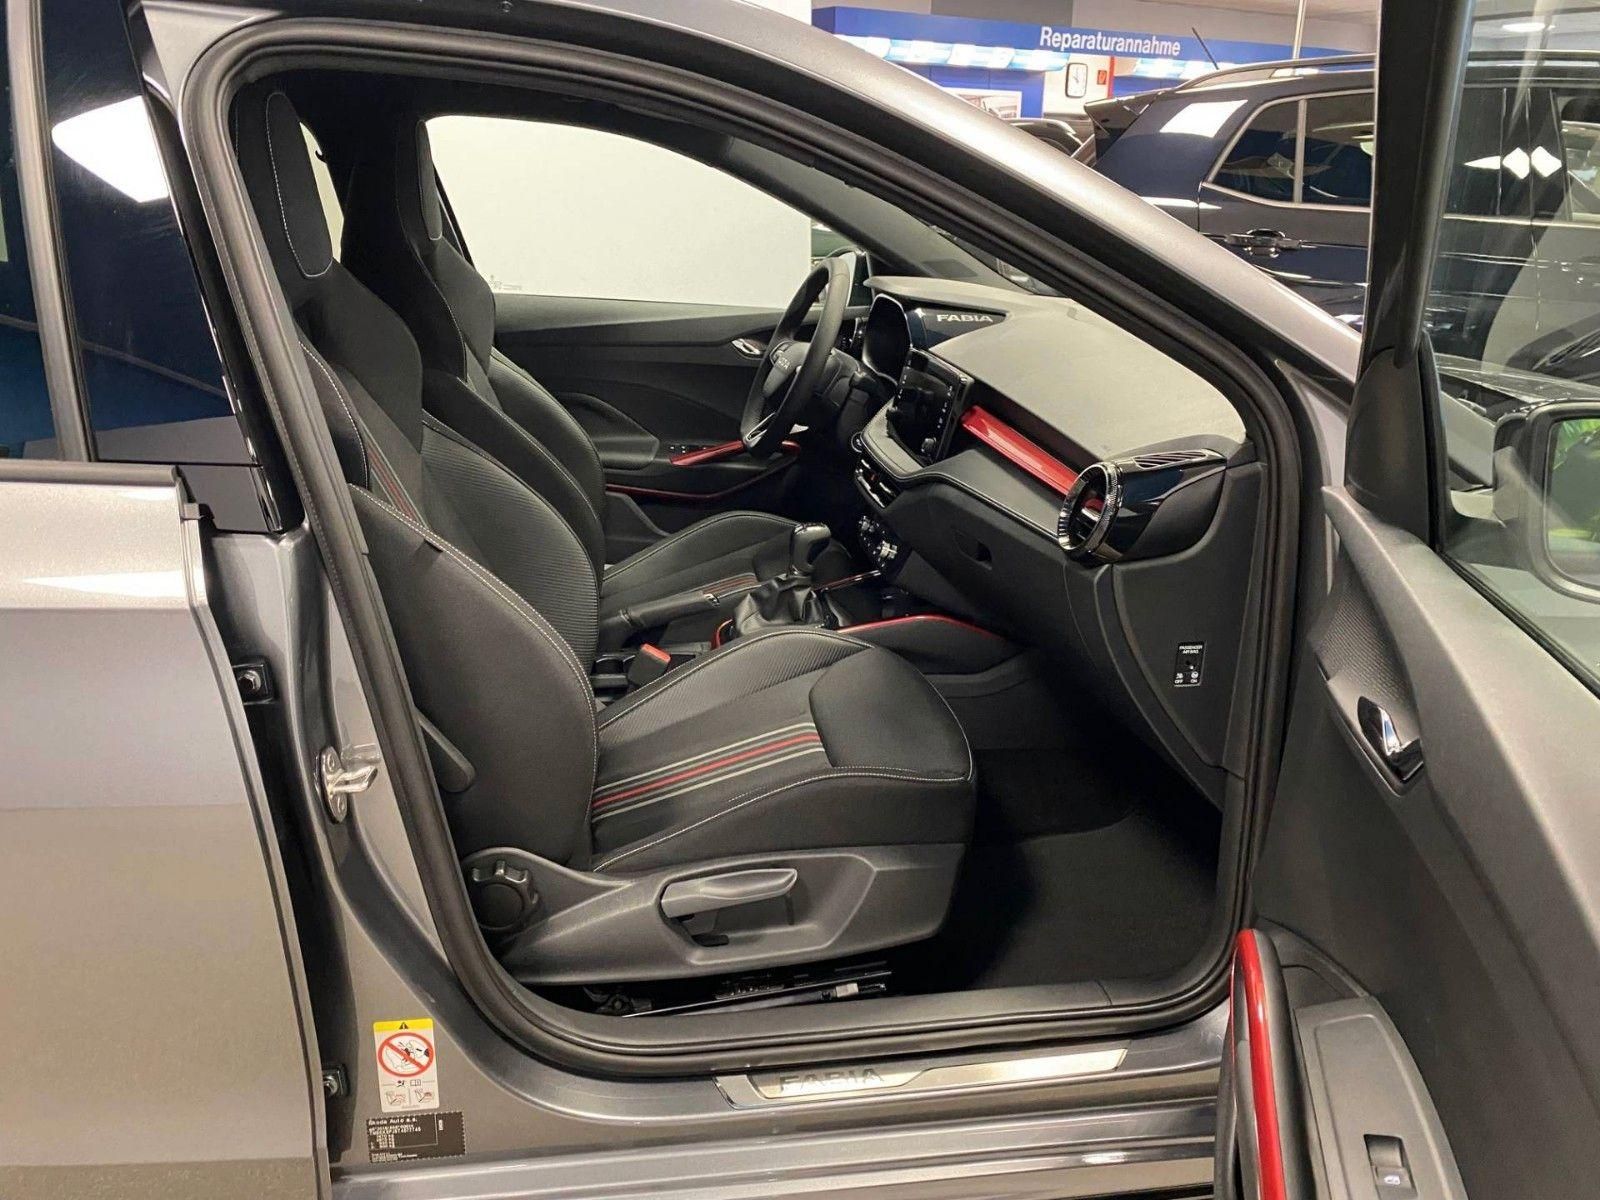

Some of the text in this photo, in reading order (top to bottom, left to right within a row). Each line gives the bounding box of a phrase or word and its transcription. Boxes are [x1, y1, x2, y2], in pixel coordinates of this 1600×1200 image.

[1039, 25, 1181, 57] Reparaturannahme
[936, 314, 994, 323] FABIA
[779, 1069, 885, 1092] FABIA
